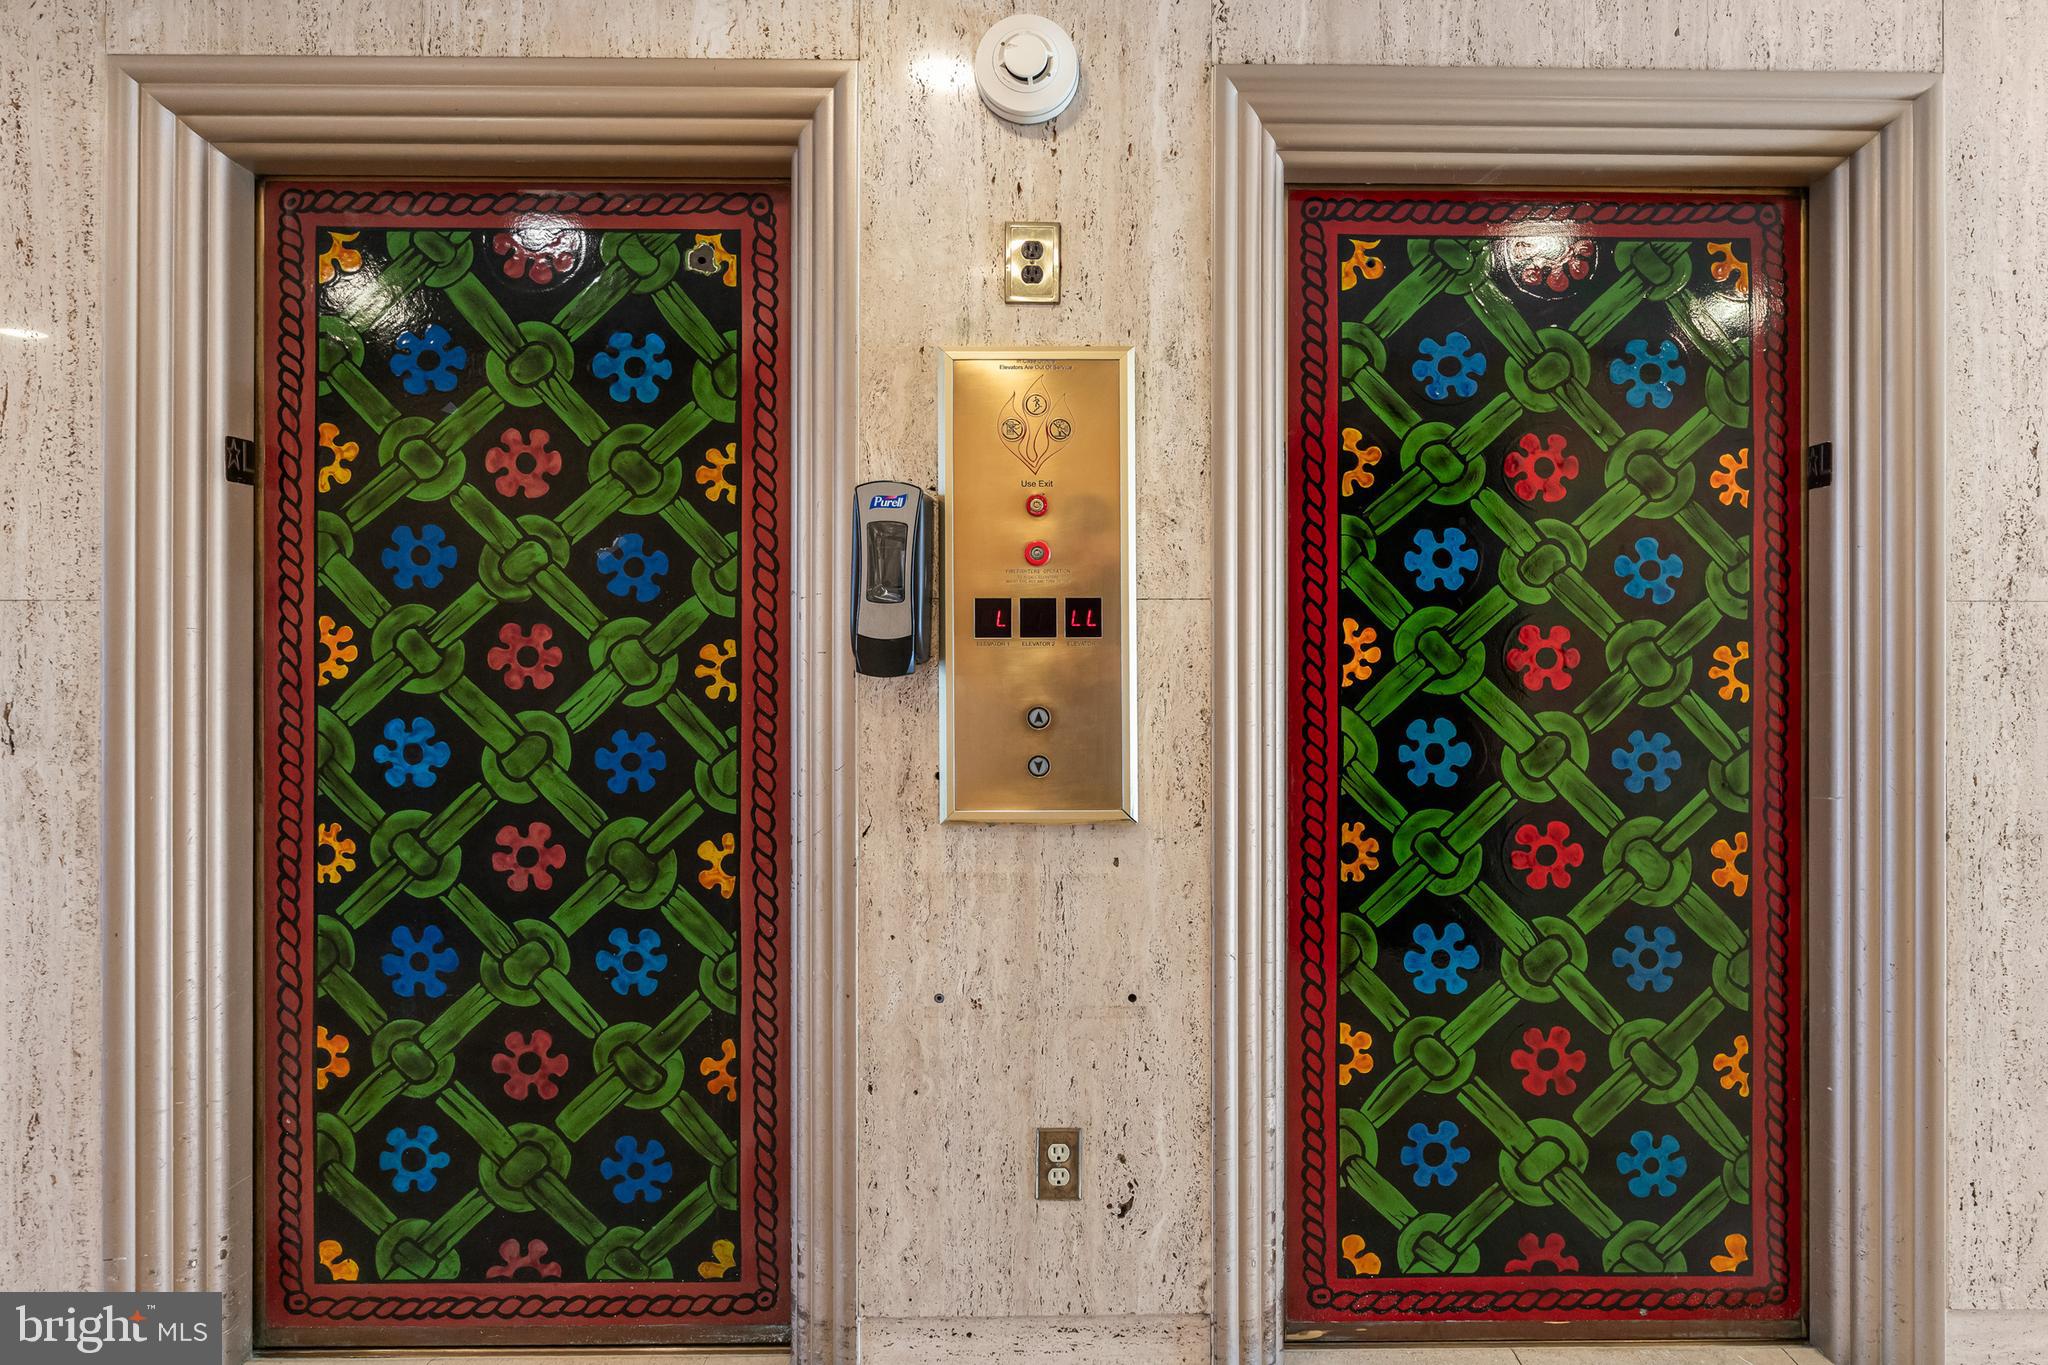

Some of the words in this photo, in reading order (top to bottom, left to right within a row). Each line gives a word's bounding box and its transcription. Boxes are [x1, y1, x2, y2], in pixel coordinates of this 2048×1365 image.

[1021, 480, 1036, 488] Use
[1038, 480, 1054, 488] Exit
[873, 496, 904, 508] Purell
[996, 609, 1006, 628] L
